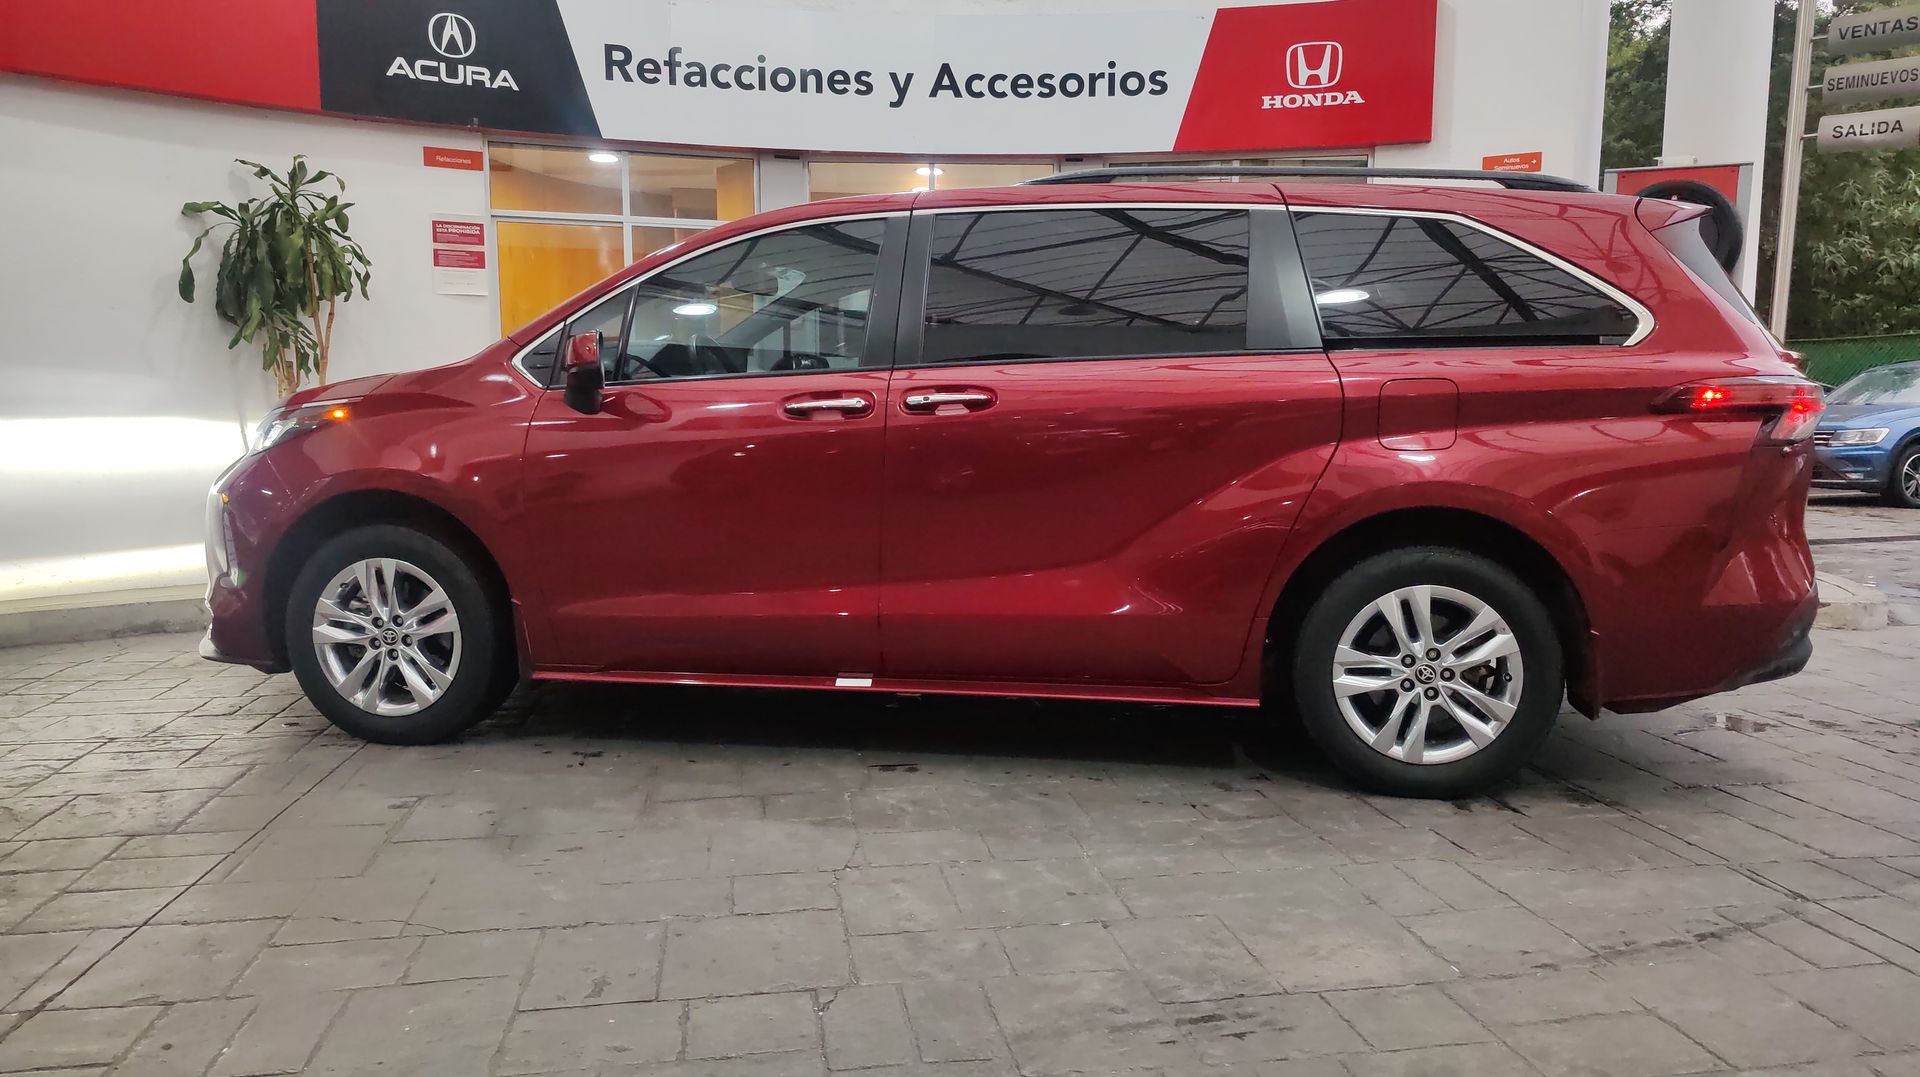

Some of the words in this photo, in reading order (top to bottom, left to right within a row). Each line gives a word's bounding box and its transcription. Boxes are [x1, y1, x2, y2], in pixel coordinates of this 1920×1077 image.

[1838, 16, 1919, 40] VENTAS
[386, 57, 519, 91] ACURA
[604, 43, 874, 96] Refacciones
[889, 70, 914, 108] y
[929, 61, 1169, 99] Accesorios
[1827, 68, 1919, 91] SEMINUEVOS
[1261, 90, 1365, 110] HONDA
[1832, 120, 1904, 138] SALIDA
